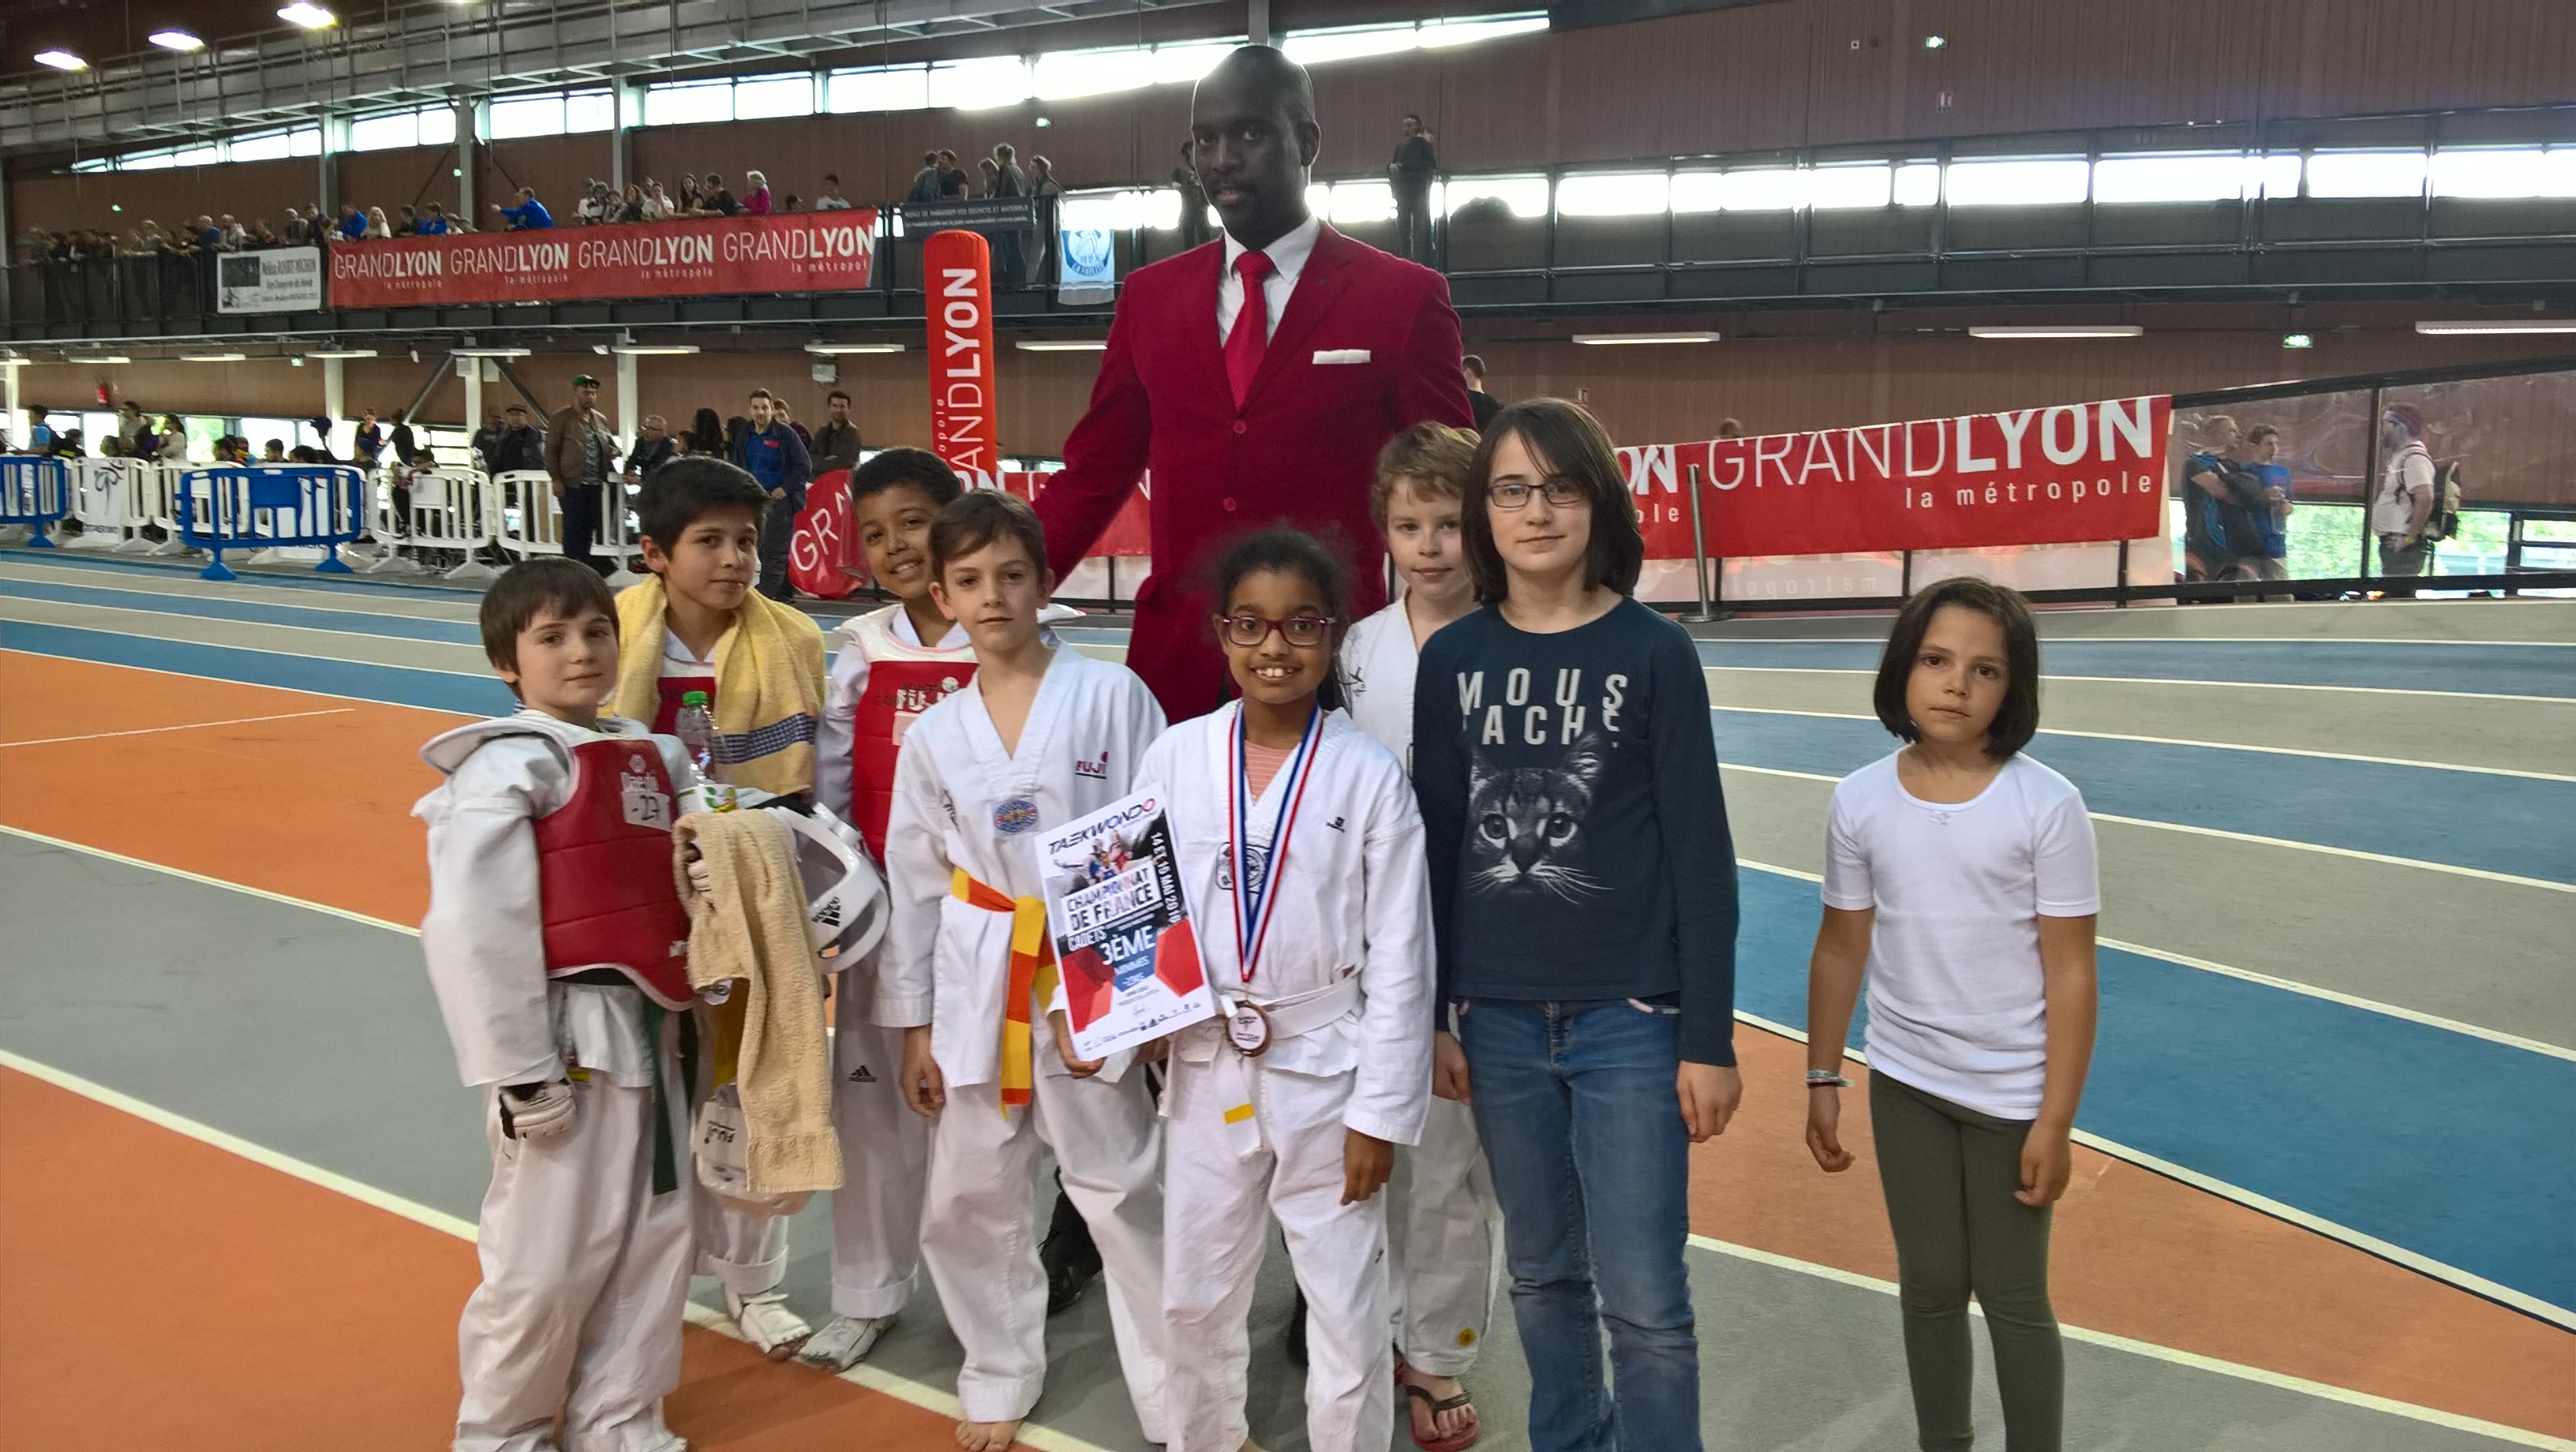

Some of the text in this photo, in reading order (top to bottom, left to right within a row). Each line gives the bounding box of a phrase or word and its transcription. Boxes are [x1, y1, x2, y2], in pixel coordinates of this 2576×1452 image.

[334, 250, 442, 279] GRANDLYON
[451, 243, 569, 275] GRANDLYON
[578, 234, 713, 268] GRANDLYON
[723, 225, 874, 262] GRANDLYON
[809, 259, 867, 272] métropol
[942, 268, 984, 472] ANDLYON
[1708, 397, 2153, 490] GRANDLYON
[1905, 471, 2151, 509] la métropole
[1048, 798, 1155, 855] TAEKWONDO
[1068, 867, 1150, 913] CHAMPIONNAT
[1069, 908, 1093, 931] DE
[1094, 883, 1154, 922] FRANCE
[1160, 874, 1176, 896] MAI
[1099, 925, 1156, 966] 3ÈME
